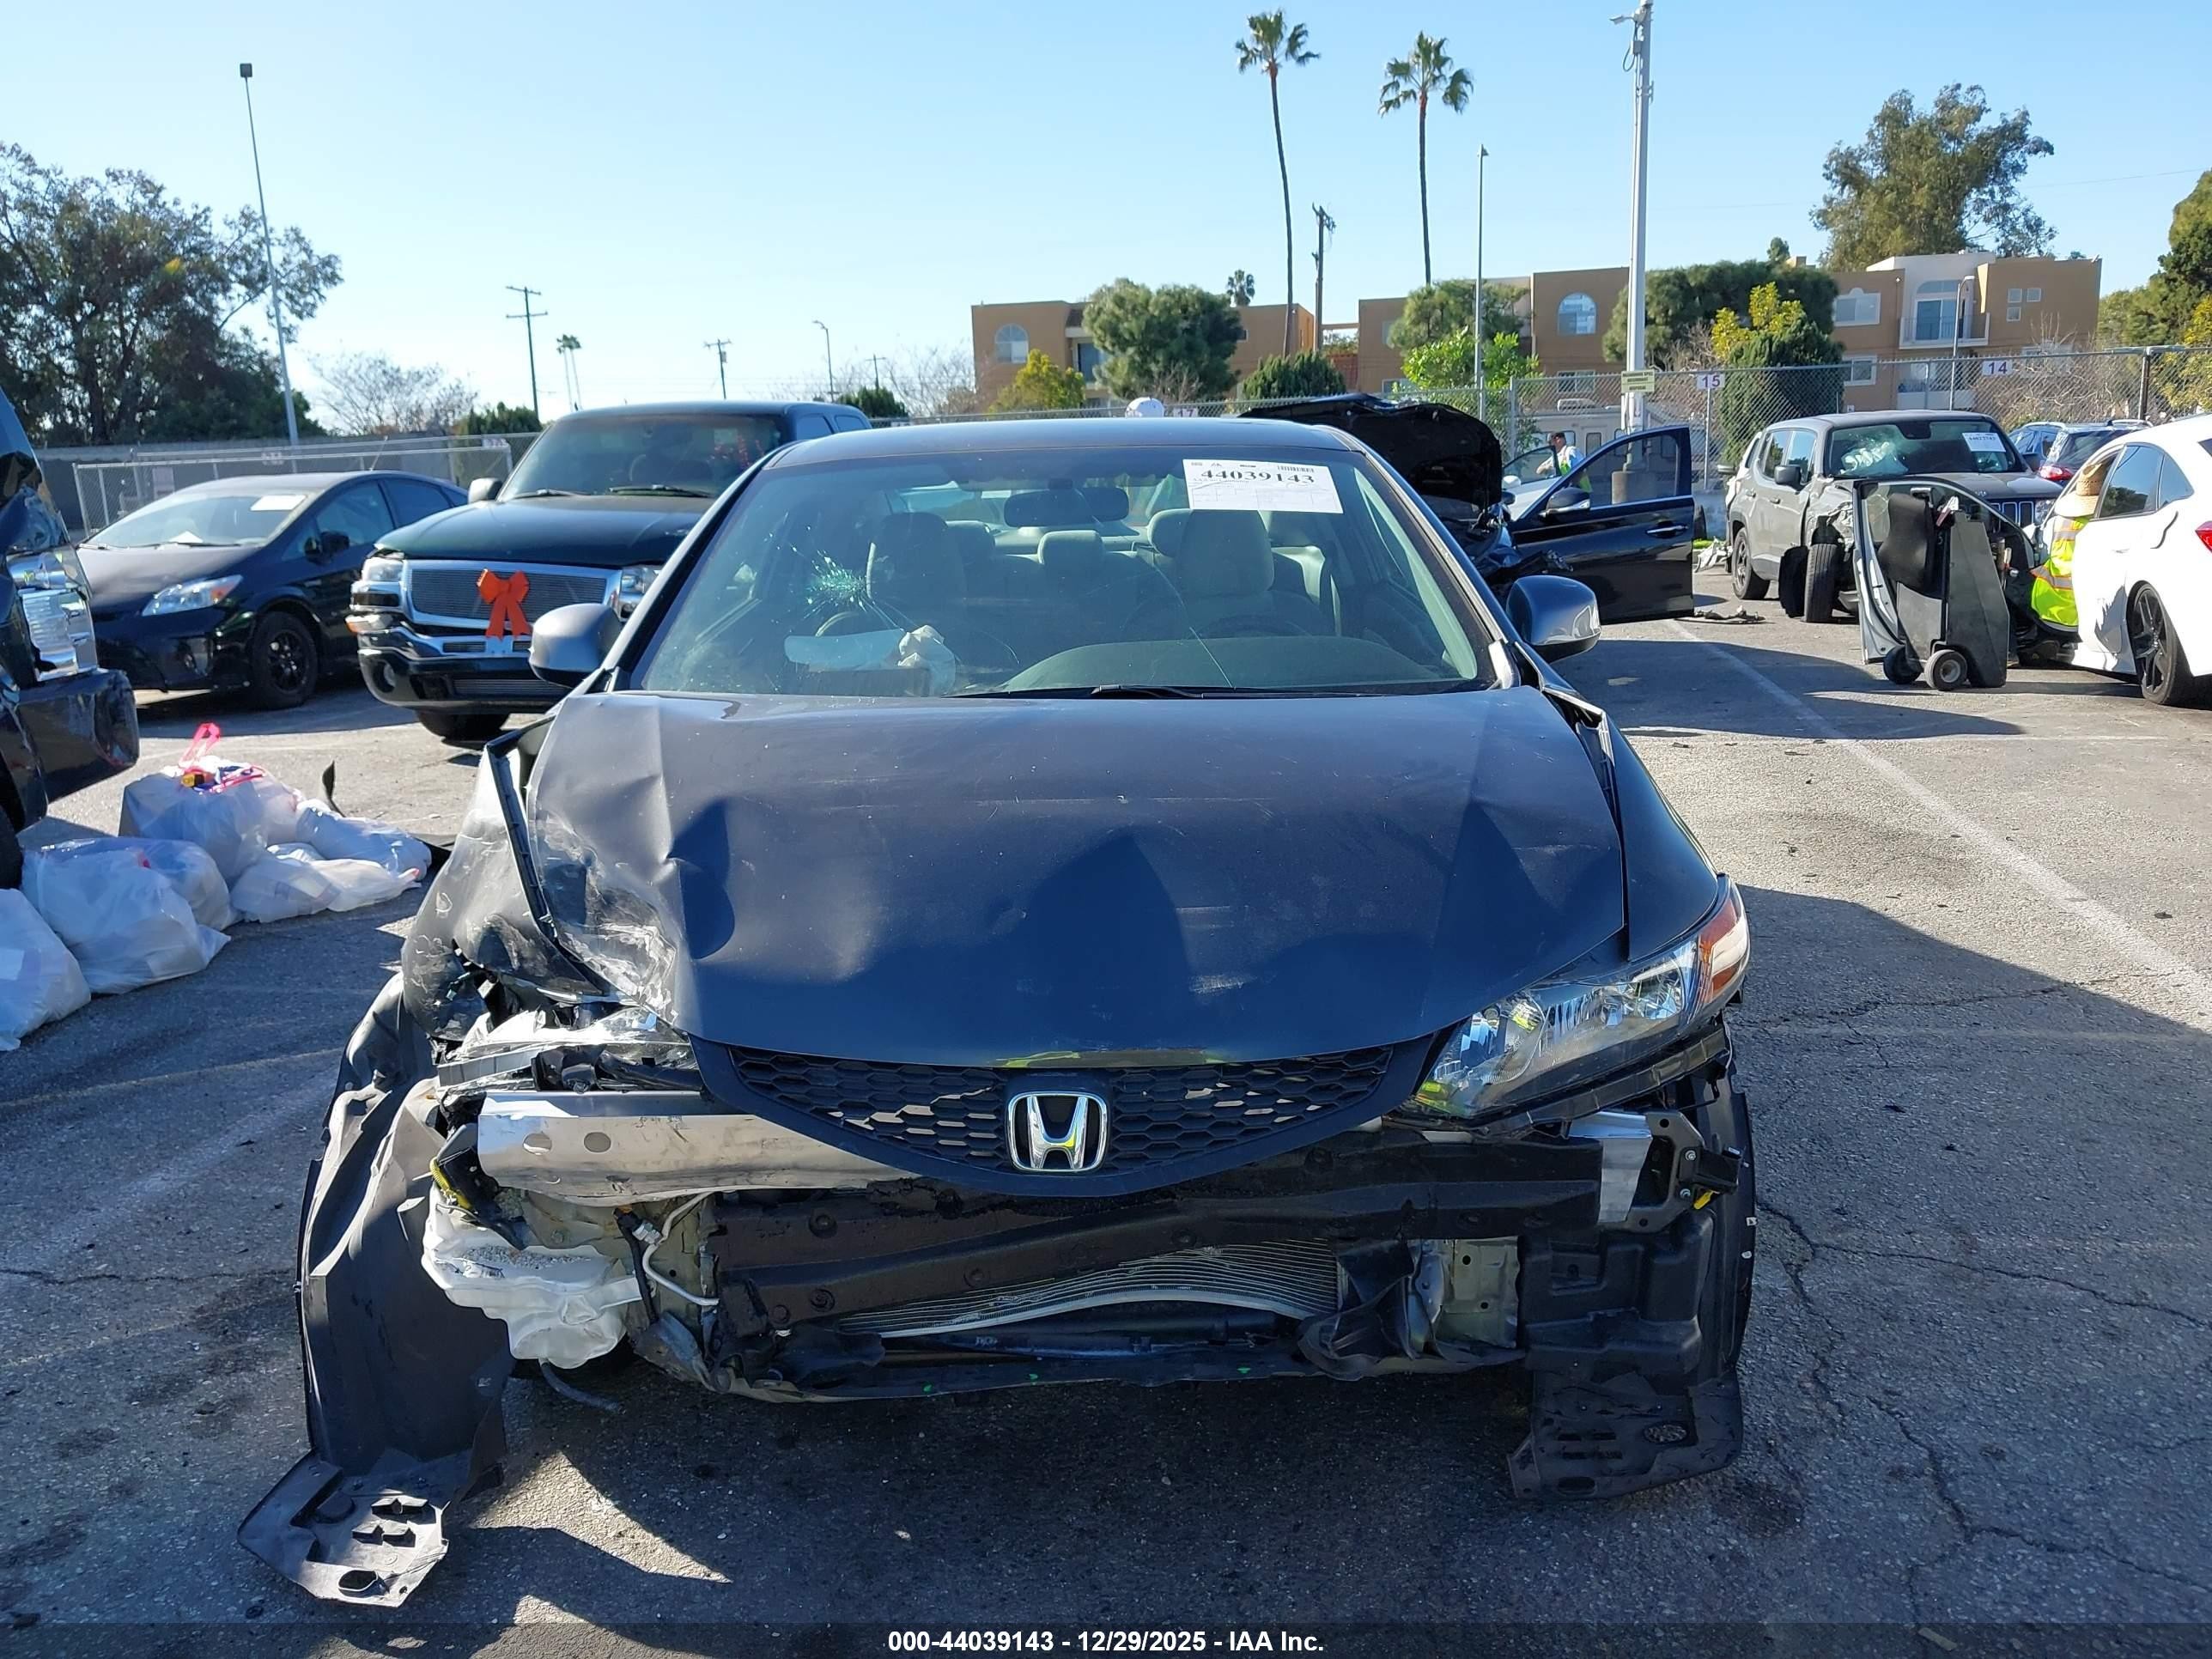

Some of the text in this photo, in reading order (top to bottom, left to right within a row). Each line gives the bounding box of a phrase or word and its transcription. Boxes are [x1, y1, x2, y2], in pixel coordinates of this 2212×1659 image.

[1988, 361, 2008, 374] 14
[1702, 374, 1721, 387] 15
[1201, 469, 1315, 483] 44039143
